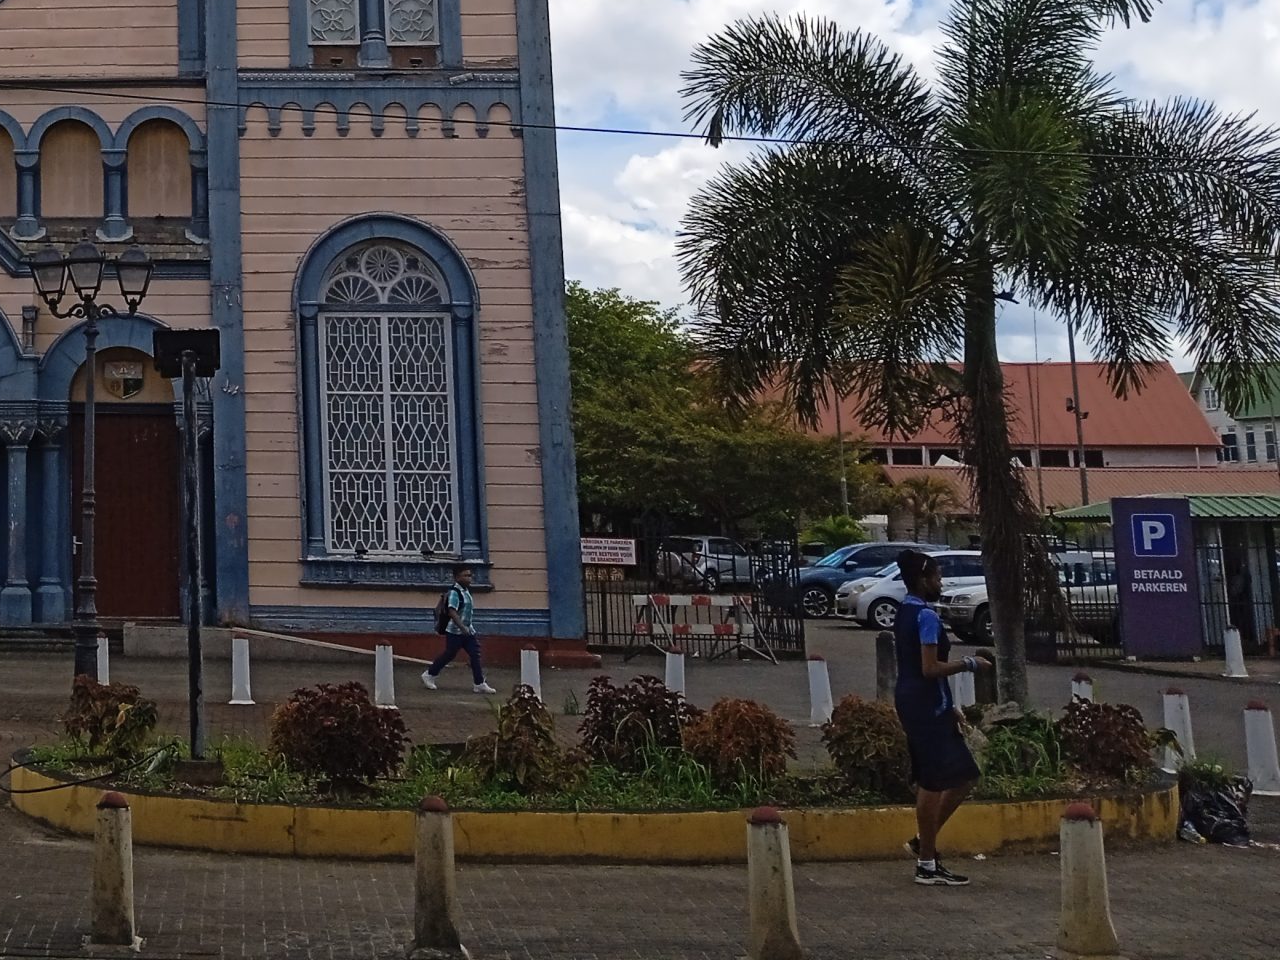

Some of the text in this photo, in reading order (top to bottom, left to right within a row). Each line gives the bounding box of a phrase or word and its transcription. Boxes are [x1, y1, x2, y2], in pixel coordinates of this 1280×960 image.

[1141, 520, 1166, 550] P
[1133, 569, 1183, 579] BETAALD
[1131, 582, 1188, 593] PARKEREN
